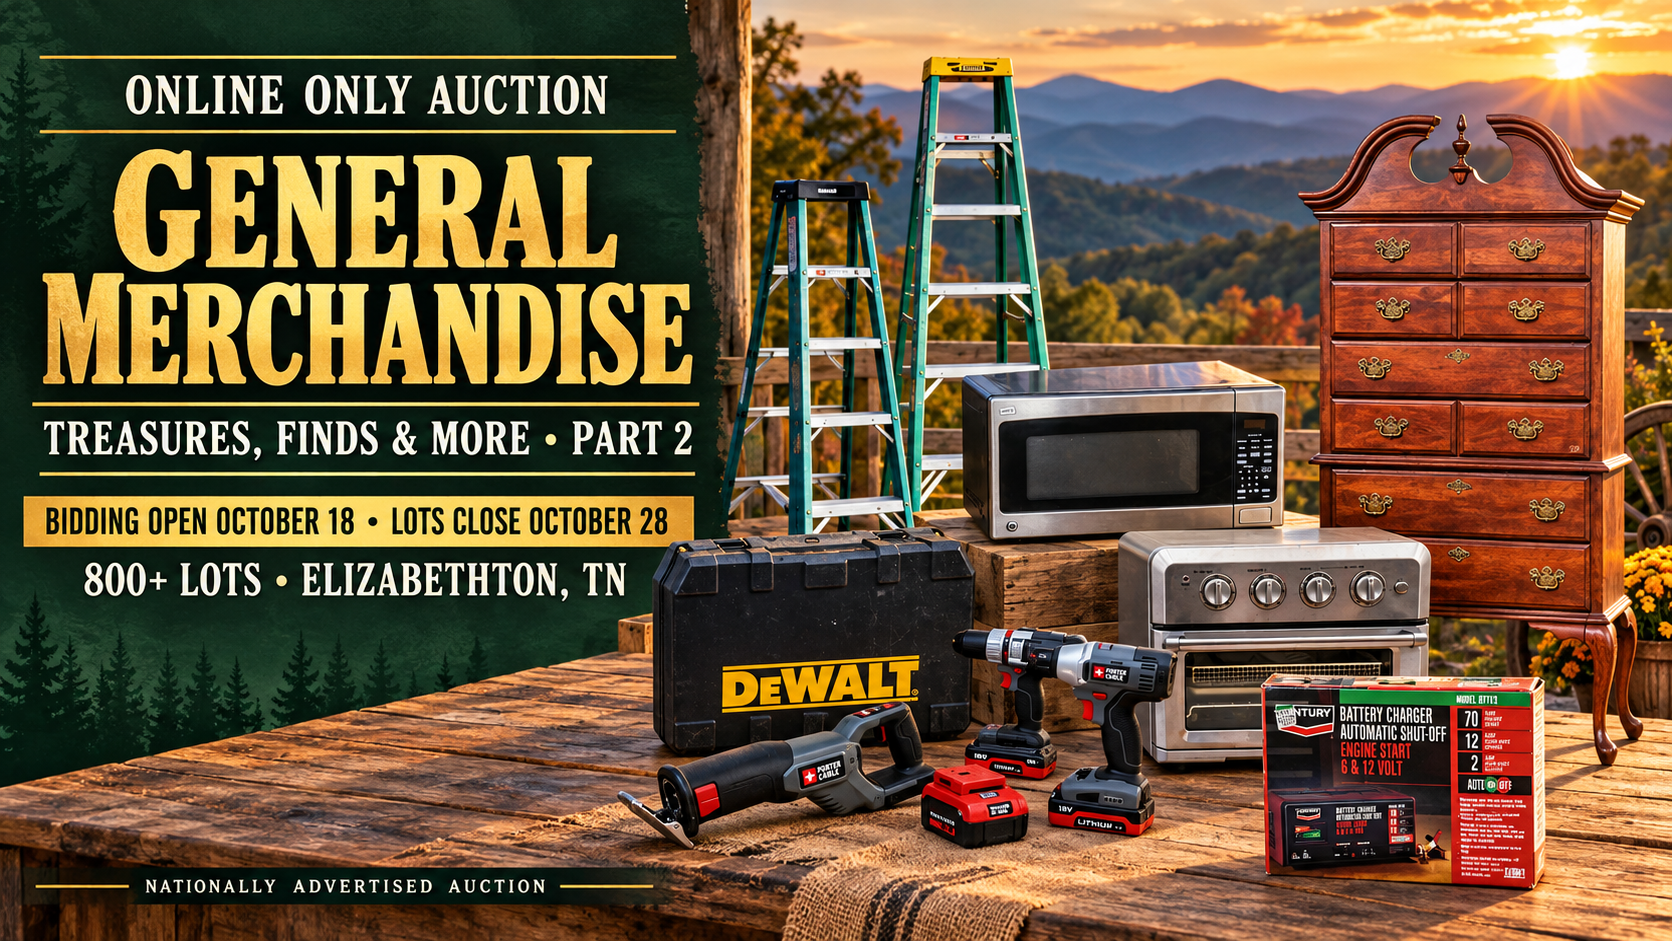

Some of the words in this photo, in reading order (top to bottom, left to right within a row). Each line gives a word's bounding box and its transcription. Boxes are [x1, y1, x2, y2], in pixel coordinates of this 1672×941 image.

[1340, 706, 1382, 723] BATTERY
[1386, 707, 1432, 724] CHARGER
[1464, 710, 1478, 727] 70
[1340, 724, 1397, 741] AUTOMATIC
[1400, 725, 1447, 742] SHUT-OFF
[1465, 733, 1478, 749] 12
[1340, 742, 1377, 758] ENGINE
[1380, 743, 1411, 759] START
[1341, 759, 1348, 774] 6
[1350, 760, 1359, 775] &
[1363, 760, 1375, 775] 12
[1377, 760, 1403, 776] VOLT
[1471, 754, 1478, 771] 2
[1058, 805, 1073, 813] 18V
